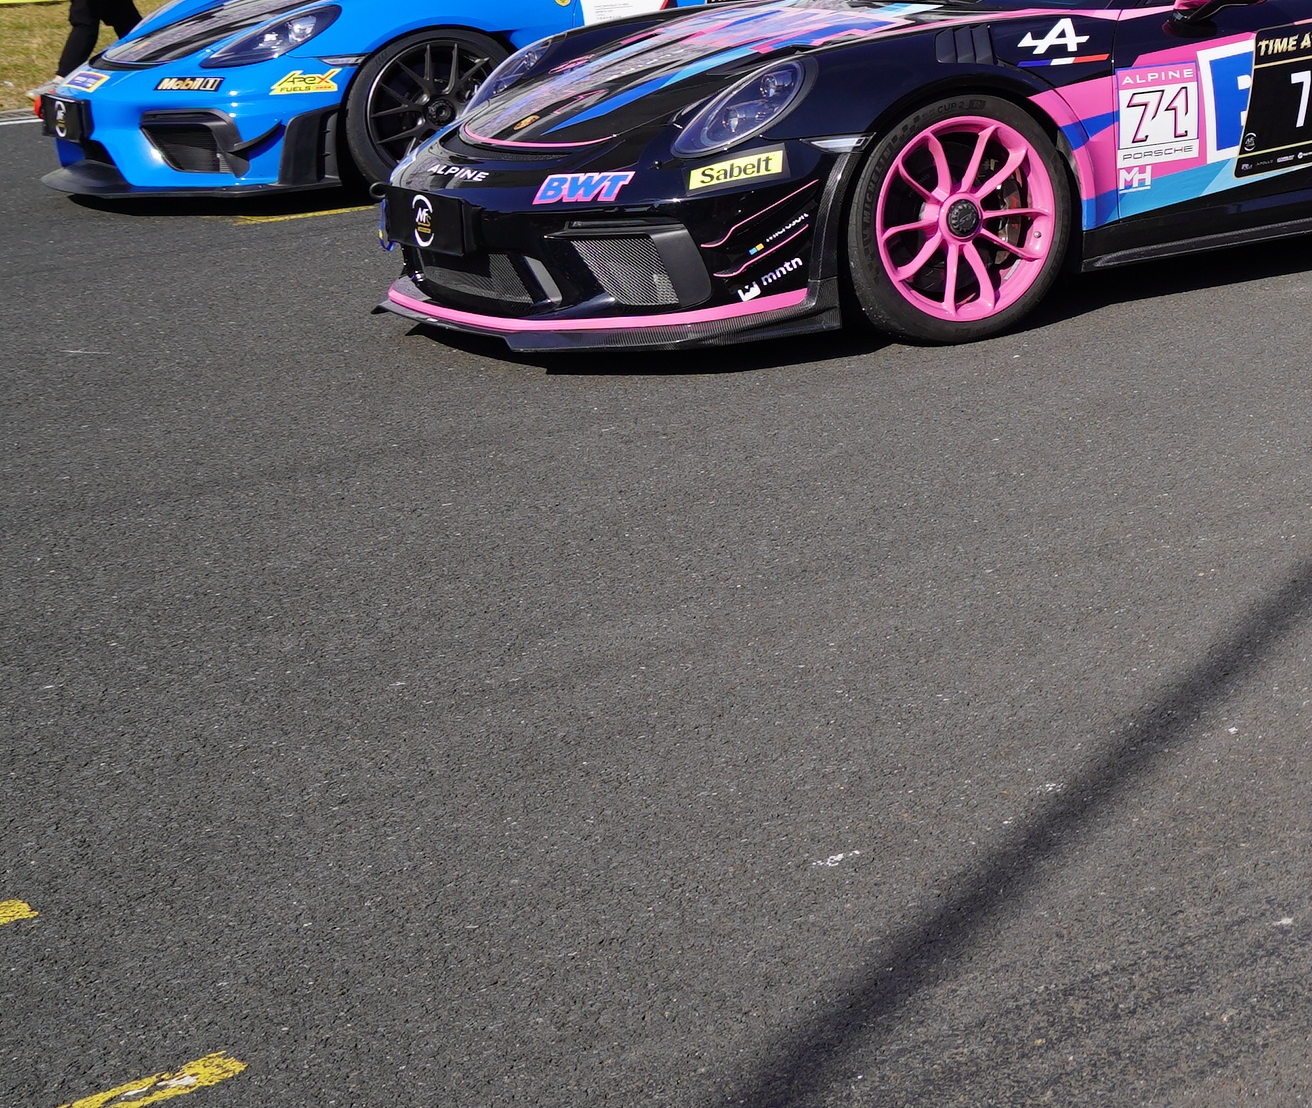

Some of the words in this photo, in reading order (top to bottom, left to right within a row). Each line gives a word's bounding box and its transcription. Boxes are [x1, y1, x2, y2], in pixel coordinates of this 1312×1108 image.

[1257, 33, 1298, 57] TIME
[1121, 68, 1194, 85] ALPINE
[1126, 86, 1189, 144] 71
[1122, 145, 1194, 162] PORSCHE
[427, 164, 490, 182] ALPINE
[700, 155, 773, 184] Sabelt
[1118, 165, 1152, 190] MH
[533, 171, 636, 205] BWT
[760, 256, 804, 286] mntn
